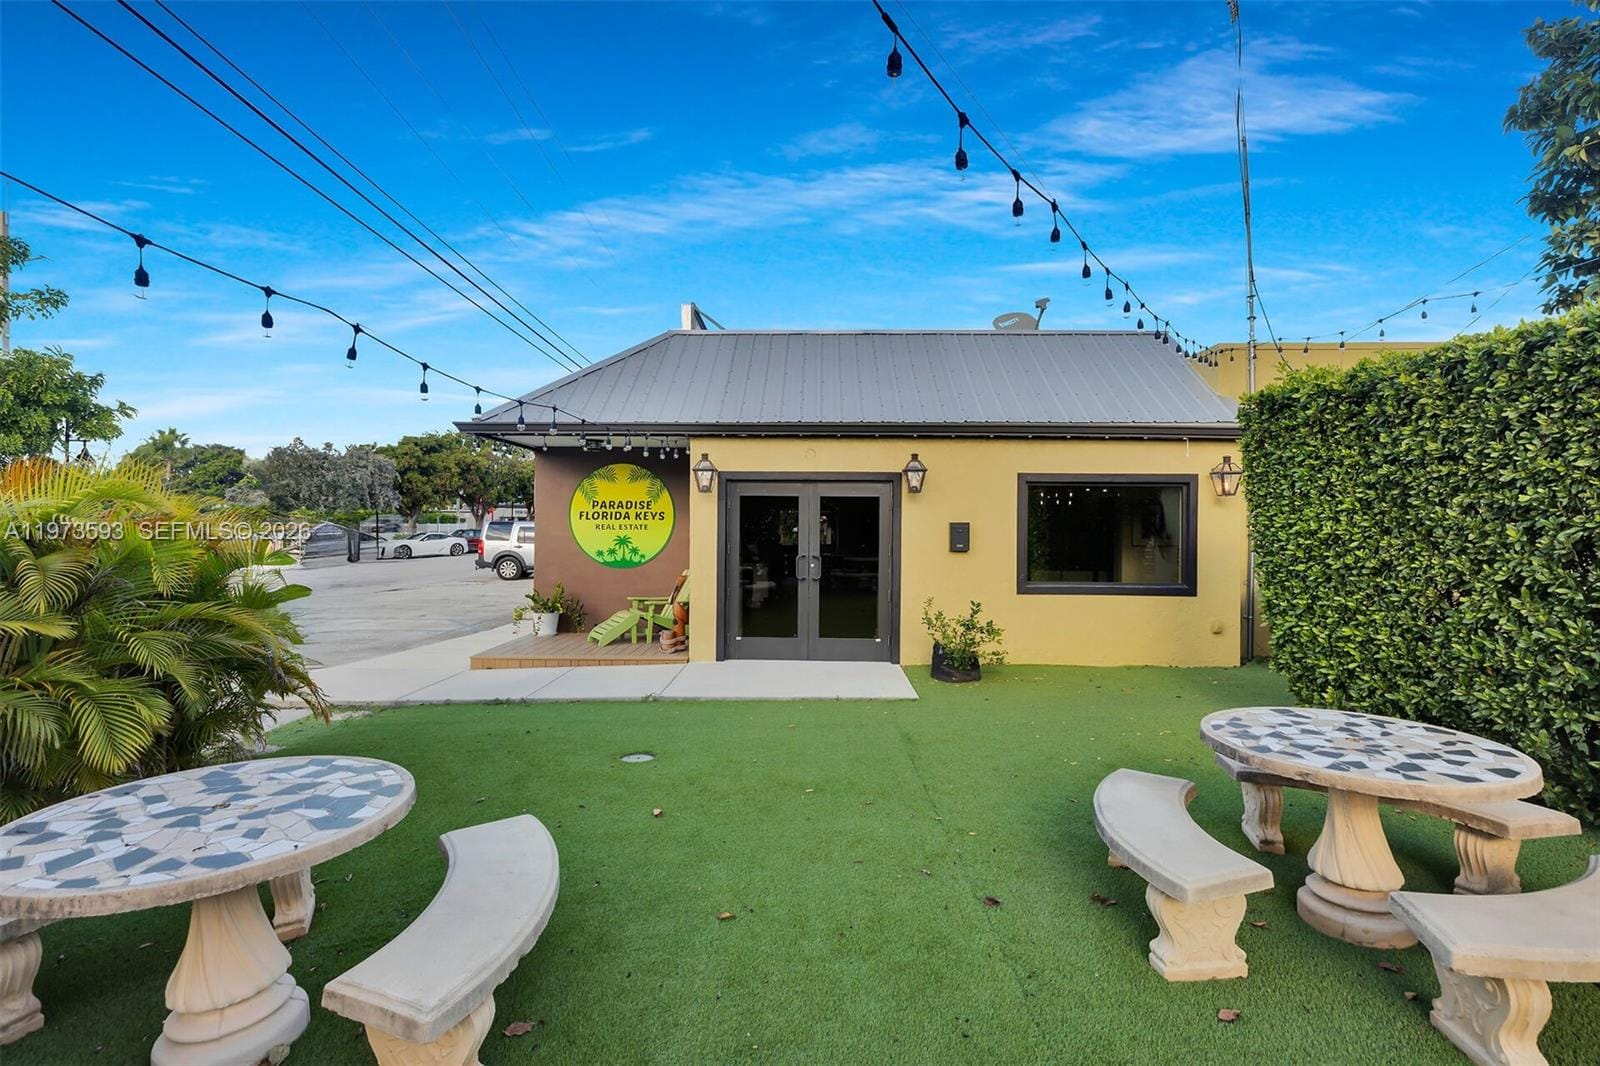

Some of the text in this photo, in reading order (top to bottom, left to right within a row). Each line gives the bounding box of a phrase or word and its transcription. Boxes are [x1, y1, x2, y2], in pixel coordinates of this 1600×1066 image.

[592, 500, 652, 510] PARADISE
[579, 511, 665, 521] FLORIDA KEYS
[595, 523, 648, 531] REAL ESTATE
